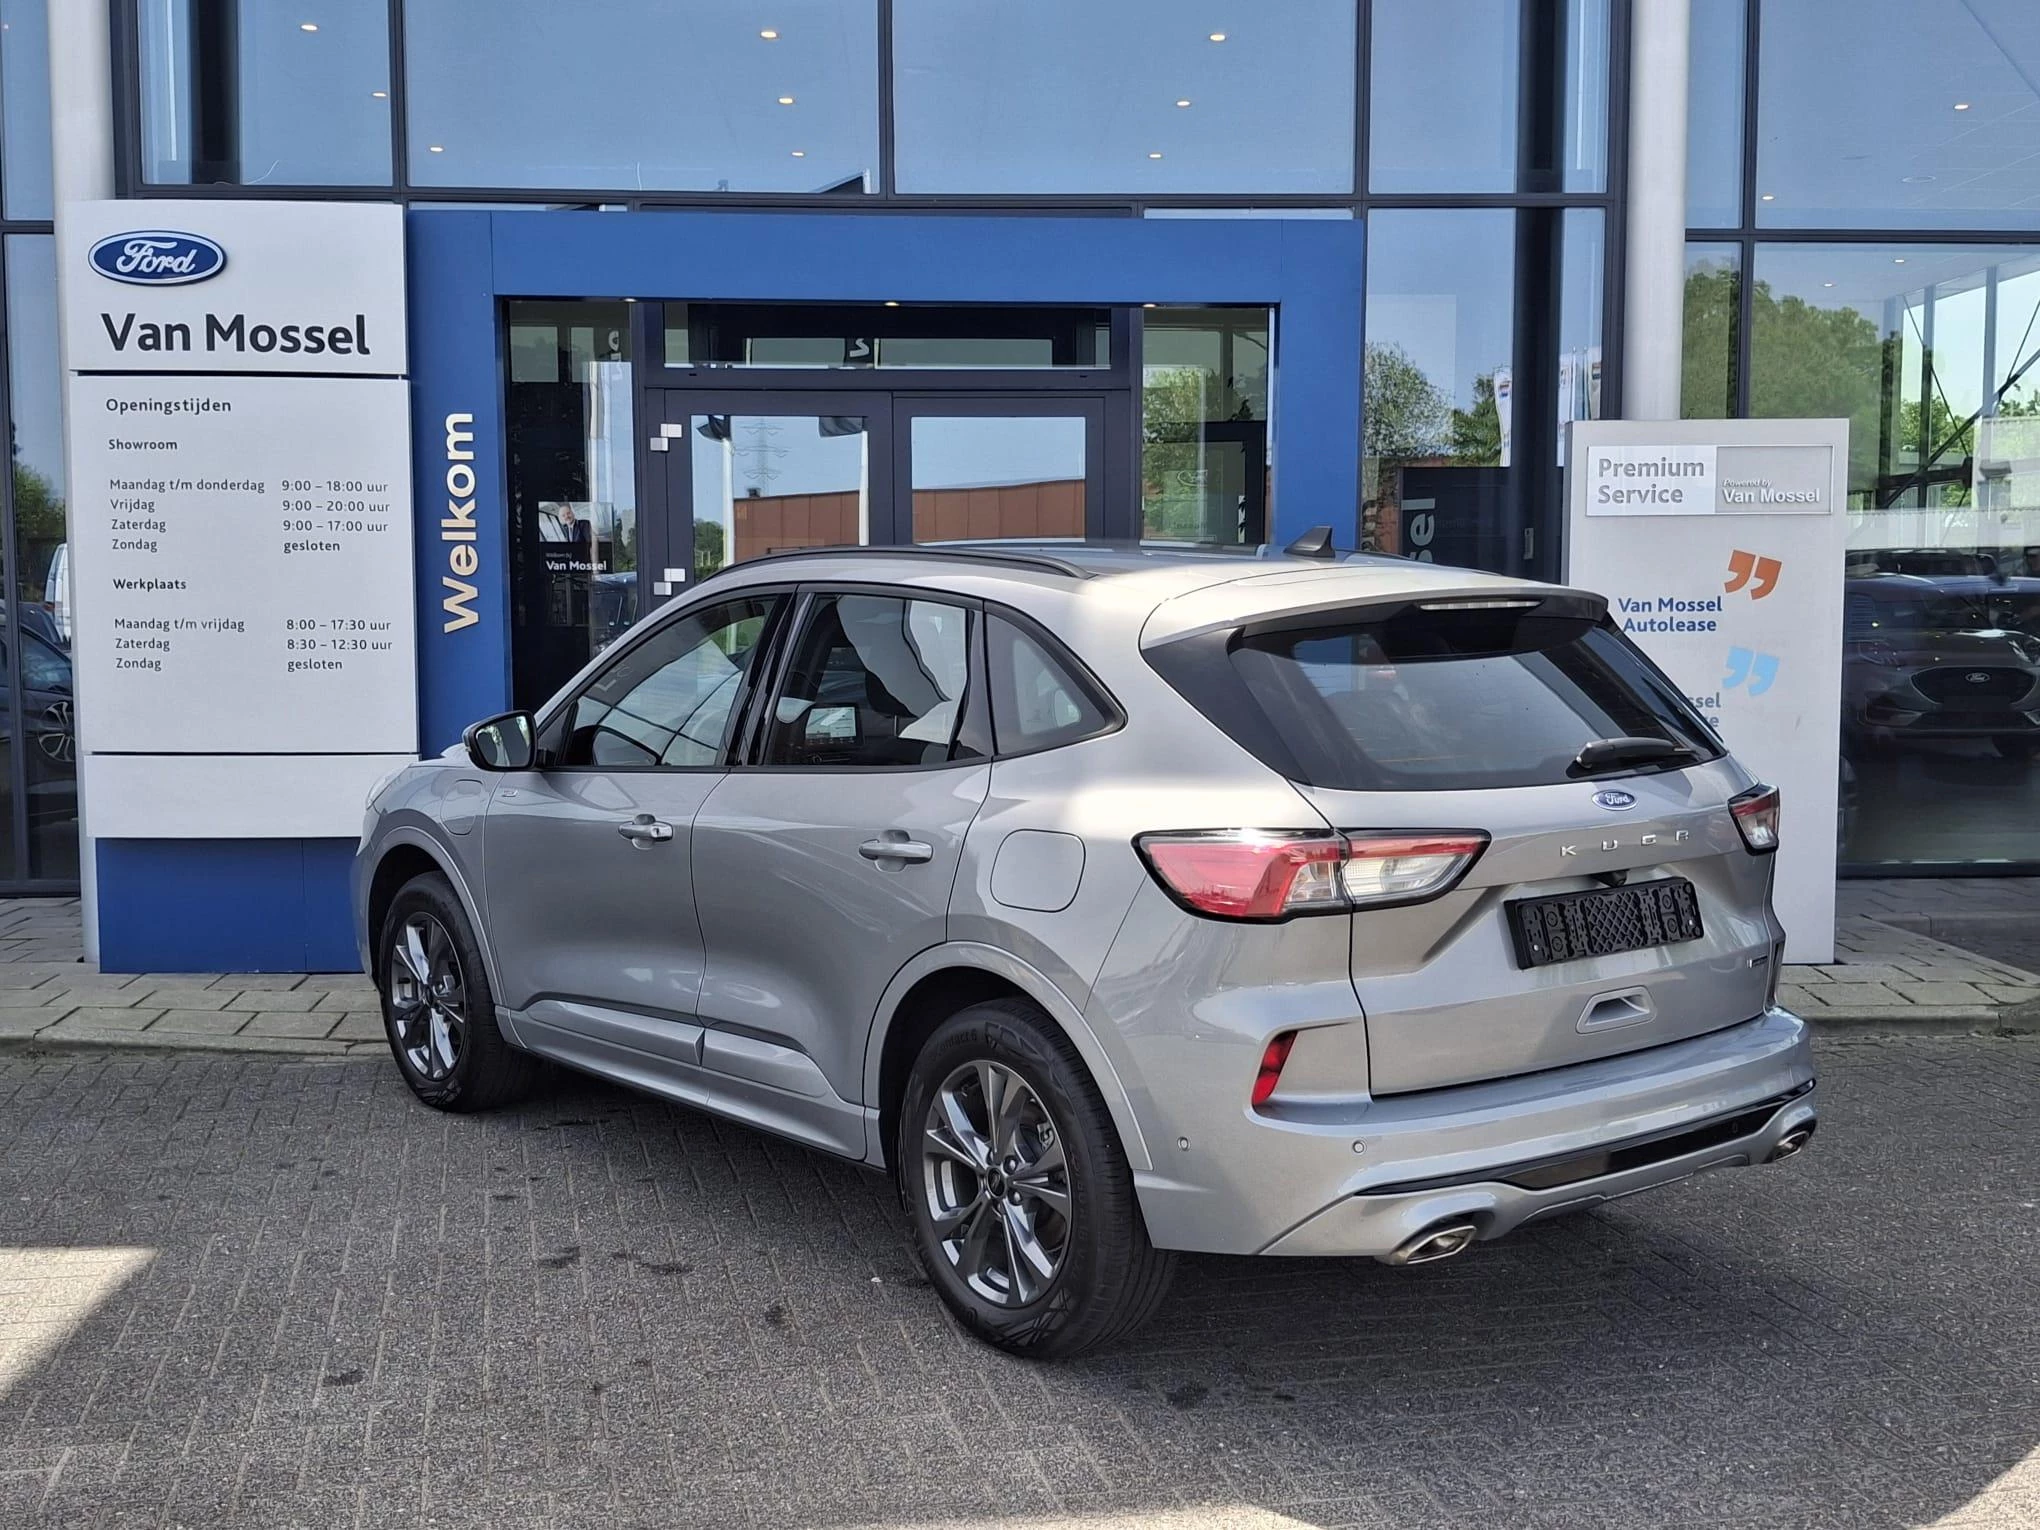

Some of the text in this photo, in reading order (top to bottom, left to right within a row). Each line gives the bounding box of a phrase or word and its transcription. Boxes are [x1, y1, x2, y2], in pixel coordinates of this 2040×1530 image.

[116, 239, 198, 273] Ford
[101, 313, 371, 355] Van Mossel
[106, 398, 232, 415] Openingstijden
[108, 438, 178, 451] Showroom
[1598, 457, 1705, 478] Premium
[110, 478, 265, 494] Maandag t/m donderdag
[281, 480, 311, 492] 9:00
[326, 480, 363, 493] 18:00
[367, 483, 388, 493] uur
[1598, 484, 1684, 504] Service
[1723, 487, 1820, 503] Van Mossel
[110, 498, 155, 513] Vrijdag
[282, 500, 312, 512] 9:00
[326, 500, 365, 512] 20:00
[369, 503, 390, 512] uur
[111, 519, 166, 533] Zaterdag
[283, 520, 312, 532] 9:00
[327, 520, 363, 532] 17:00
[367, 523, 389, 532] uur
[441, 413, 479, 634] Welkom
[112, 538, 158, 553] Zondag
[283, 539, 341, 554] gesloten
[546, 560, 607, 571] Van Mossel
[113, 578, 187, 592] Werkplaats
[1618, 595, 1723, 613] Van Mossel
[114, 618, 245, 633] Maandag t/m vrijdag
[286, 619, 316, 631] 8:00
[331, 619, 366, 631] 17:30
[370, 622, 391, 631] uur
[1623, 617, 1717, 633] Autolease
[115, 637, 170, 652] Zaterdag
[287, 639, 316, 651] 8:30
[331, 639, 367, 651] 12:30
[371, 641, 393, 651] uur
[116, 657, 162, 672] Zondag
[287, 658, 343, 672] gesloten
